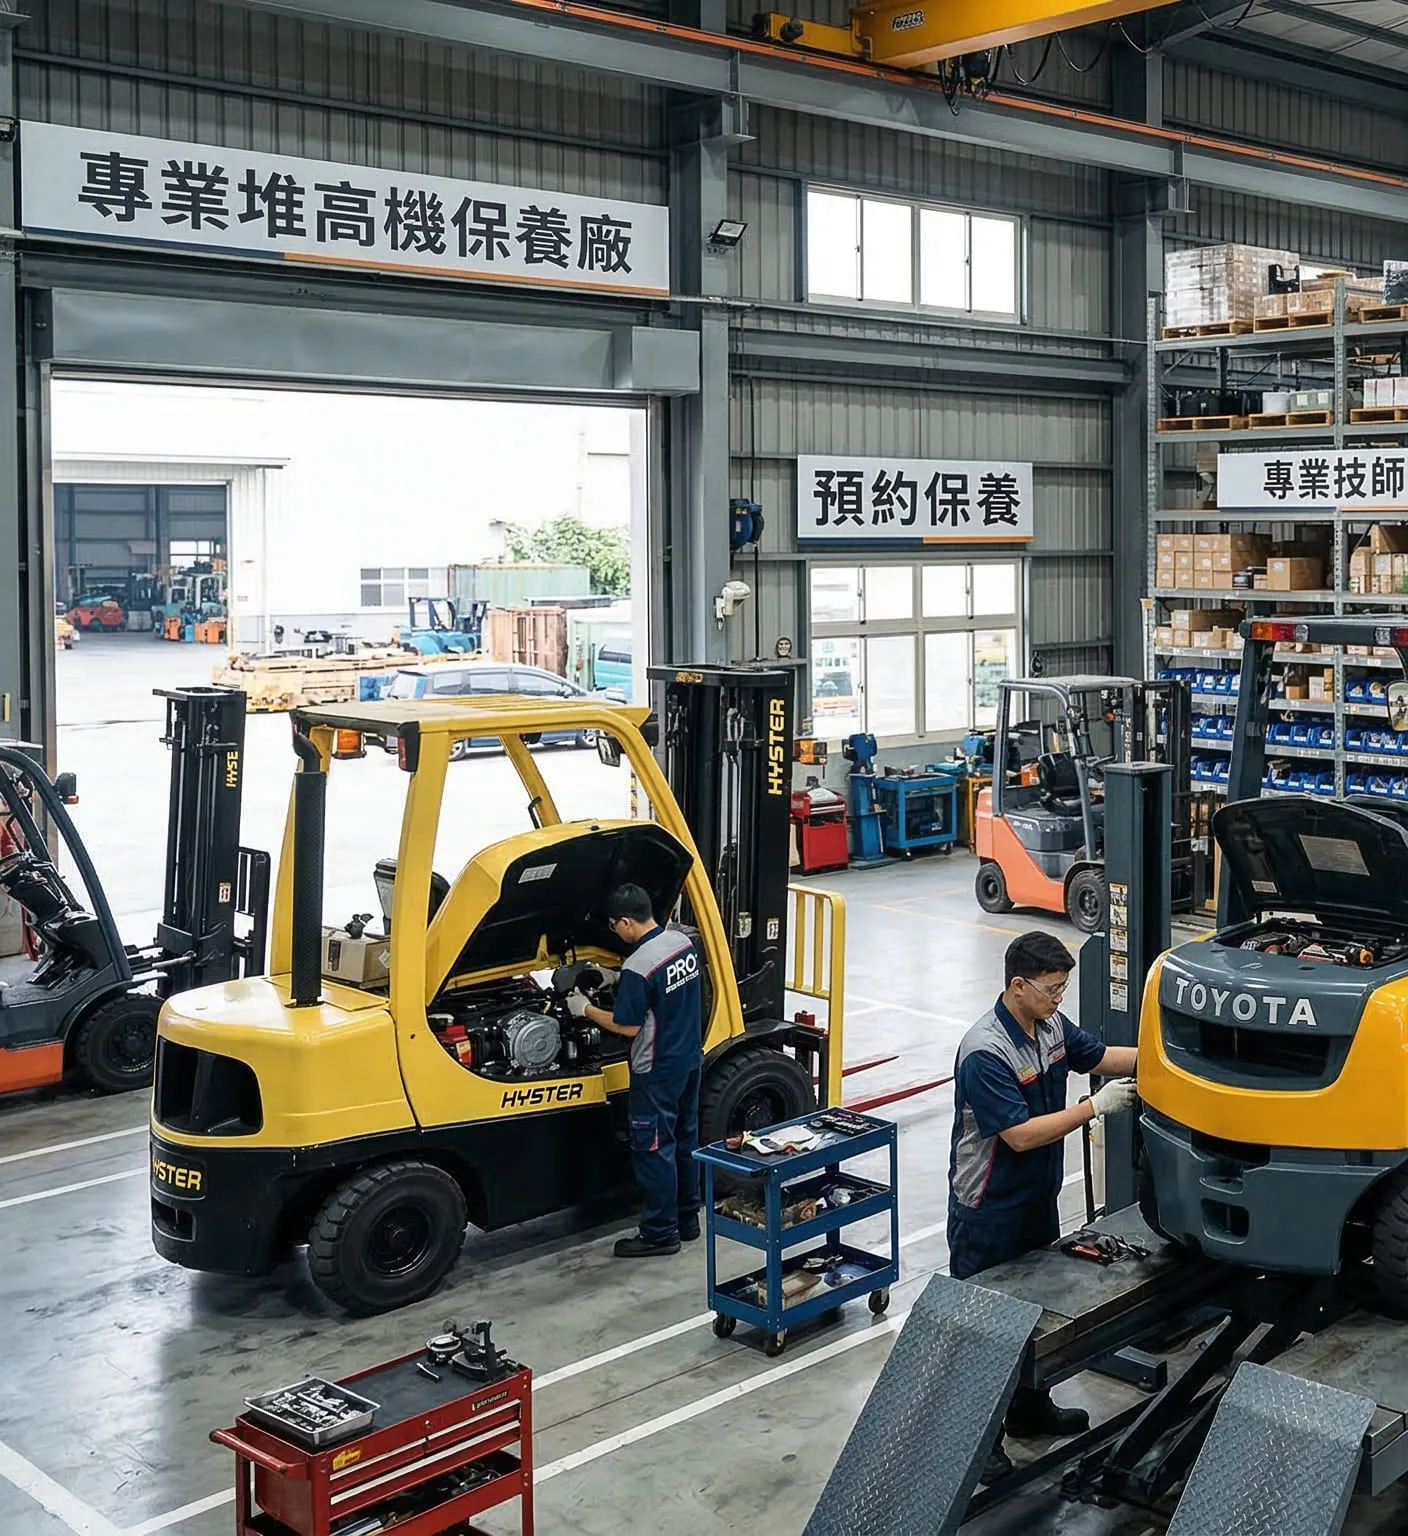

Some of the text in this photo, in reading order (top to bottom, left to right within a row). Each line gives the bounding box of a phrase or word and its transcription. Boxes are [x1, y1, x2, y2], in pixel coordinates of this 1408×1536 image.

[77, 150, 634, 275] 專業堆高機保養廠
[813, 469, 1021, 527] 預約保養
[768, 698, 785, 796] HYSTER
[666, 953, 697, 986] PRO
[1175, 976, 1317, 1026] TOYOTA
[501, 1083, 584, 1108] HYSTER
